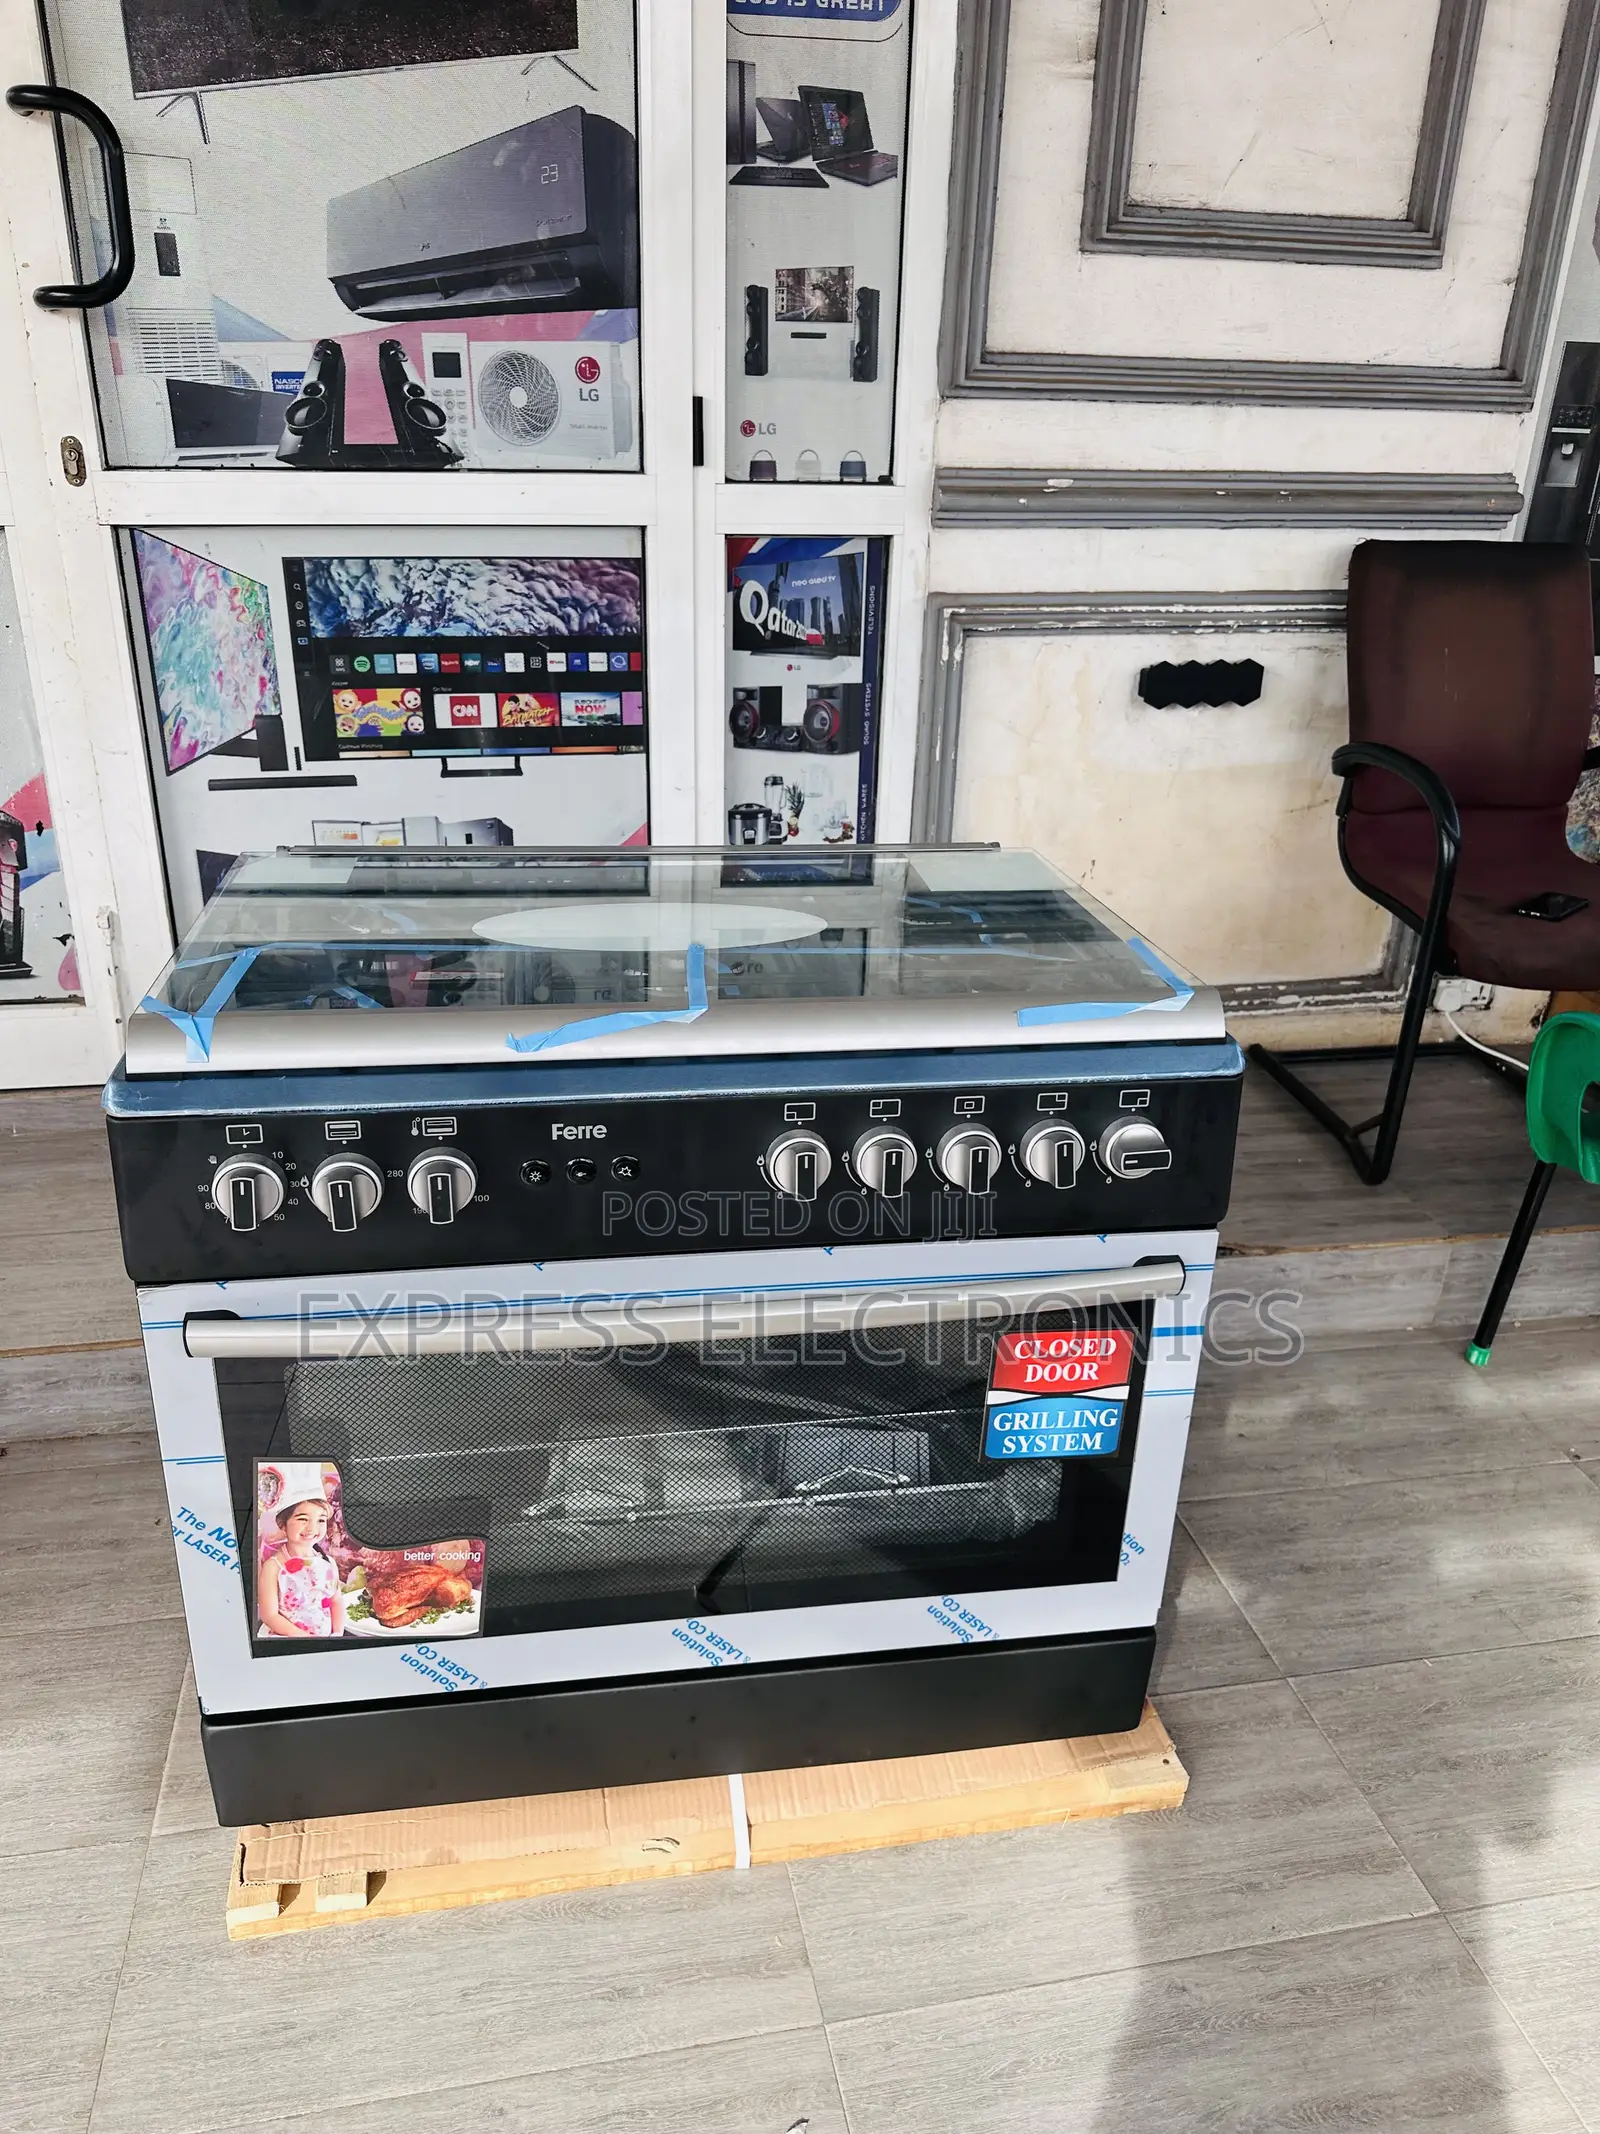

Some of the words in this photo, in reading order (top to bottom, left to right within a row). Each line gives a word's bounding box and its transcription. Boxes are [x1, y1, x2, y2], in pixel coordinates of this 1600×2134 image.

[540, 163, 559, 185] 23
[579, 388, 600, 402] LG
[758, 422, 777, 436] LG
[867, 584, 877, 636] TELEVISIONS
[452, 704, 479, 718] CNN
[864, 682, 873, 718] SYSTEMS
[863, 720, 871, 746] SOUND
[551, 1123, 608, 1140] Ferre
[271, 1151, 284, 1159] 10
[284, 1162, 297, 1171] 20
[386, 1169, 404, 1178] 280
[197, 1184, 210, 1192] 90
[473, 1194, 490, 1203] 100
[204, 1202, 216, 1210] 80
[287, 1198, 299, 1206] 40
[273, 1213, 285, 1221] 50
[1014, 1337, 1117, 1360] CLOSED
[1023, 1362, 1100, 1383] DOOR
[993, 1408, 1119, 1431] GRILLING
[1002, 1432, 1104, 1454] SYSTEM
[176, 1506, 207, 1531] The
[207, 1526, 239, 1552] No
[183, 1533, 231, 1567] LASER
[1122, 1533, 1145, 1555] tion
[403, 1550, 436, 1561] better
[439, 1550, 481, 1562] cooking
[927, 1605, 974, 1644] Solution
[958, 1608, 993, 1637] LASER
[671, 1628, 723, 1667] Solution
[705, 1631, 744, 1660] LASER
[400, 1653, 458, 1692] Solution
[437, 1656, 479, 1686] LASER
